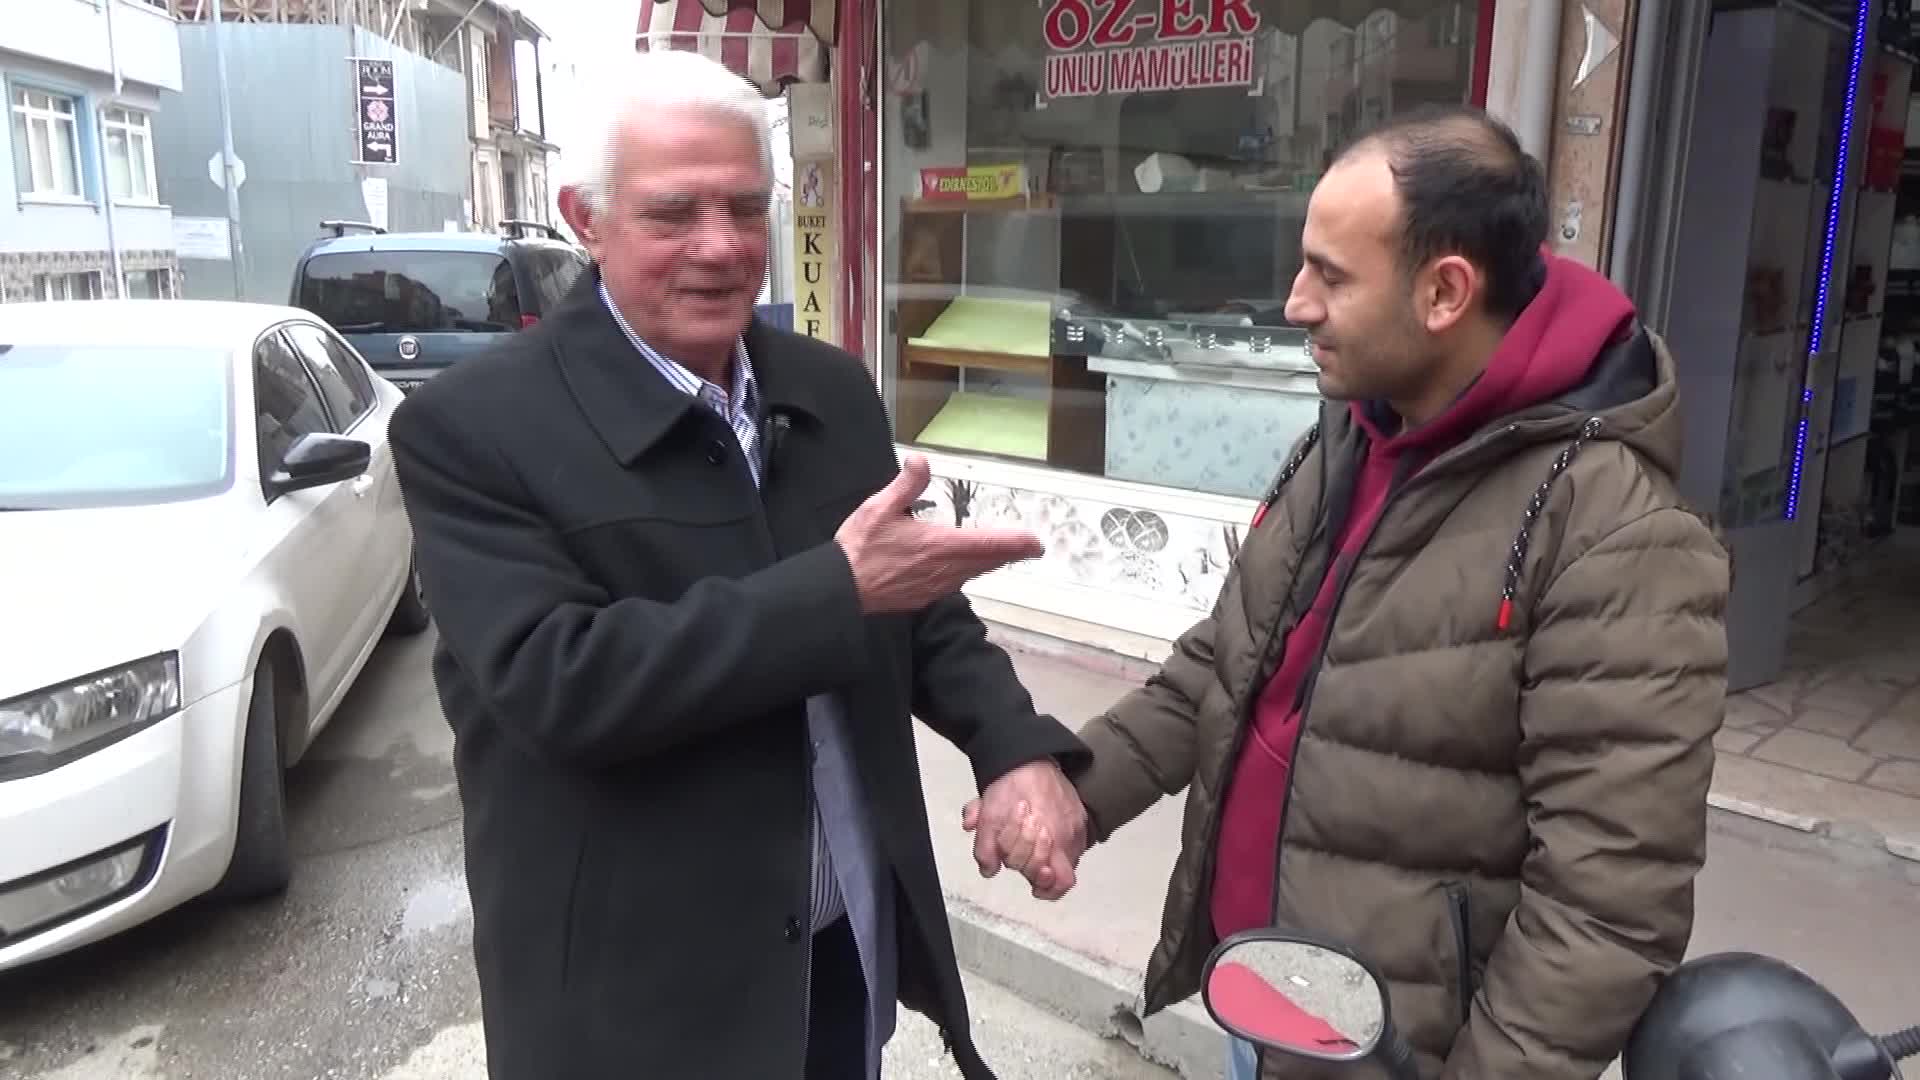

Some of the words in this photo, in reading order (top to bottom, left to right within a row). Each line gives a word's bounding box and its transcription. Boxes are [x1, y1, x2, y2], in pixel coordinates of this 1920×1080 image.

[1047, 53, 1104, 97] UNLU
[363, 121, 394, 132] GRAND
[798, 215, 826, 229] BUKET
